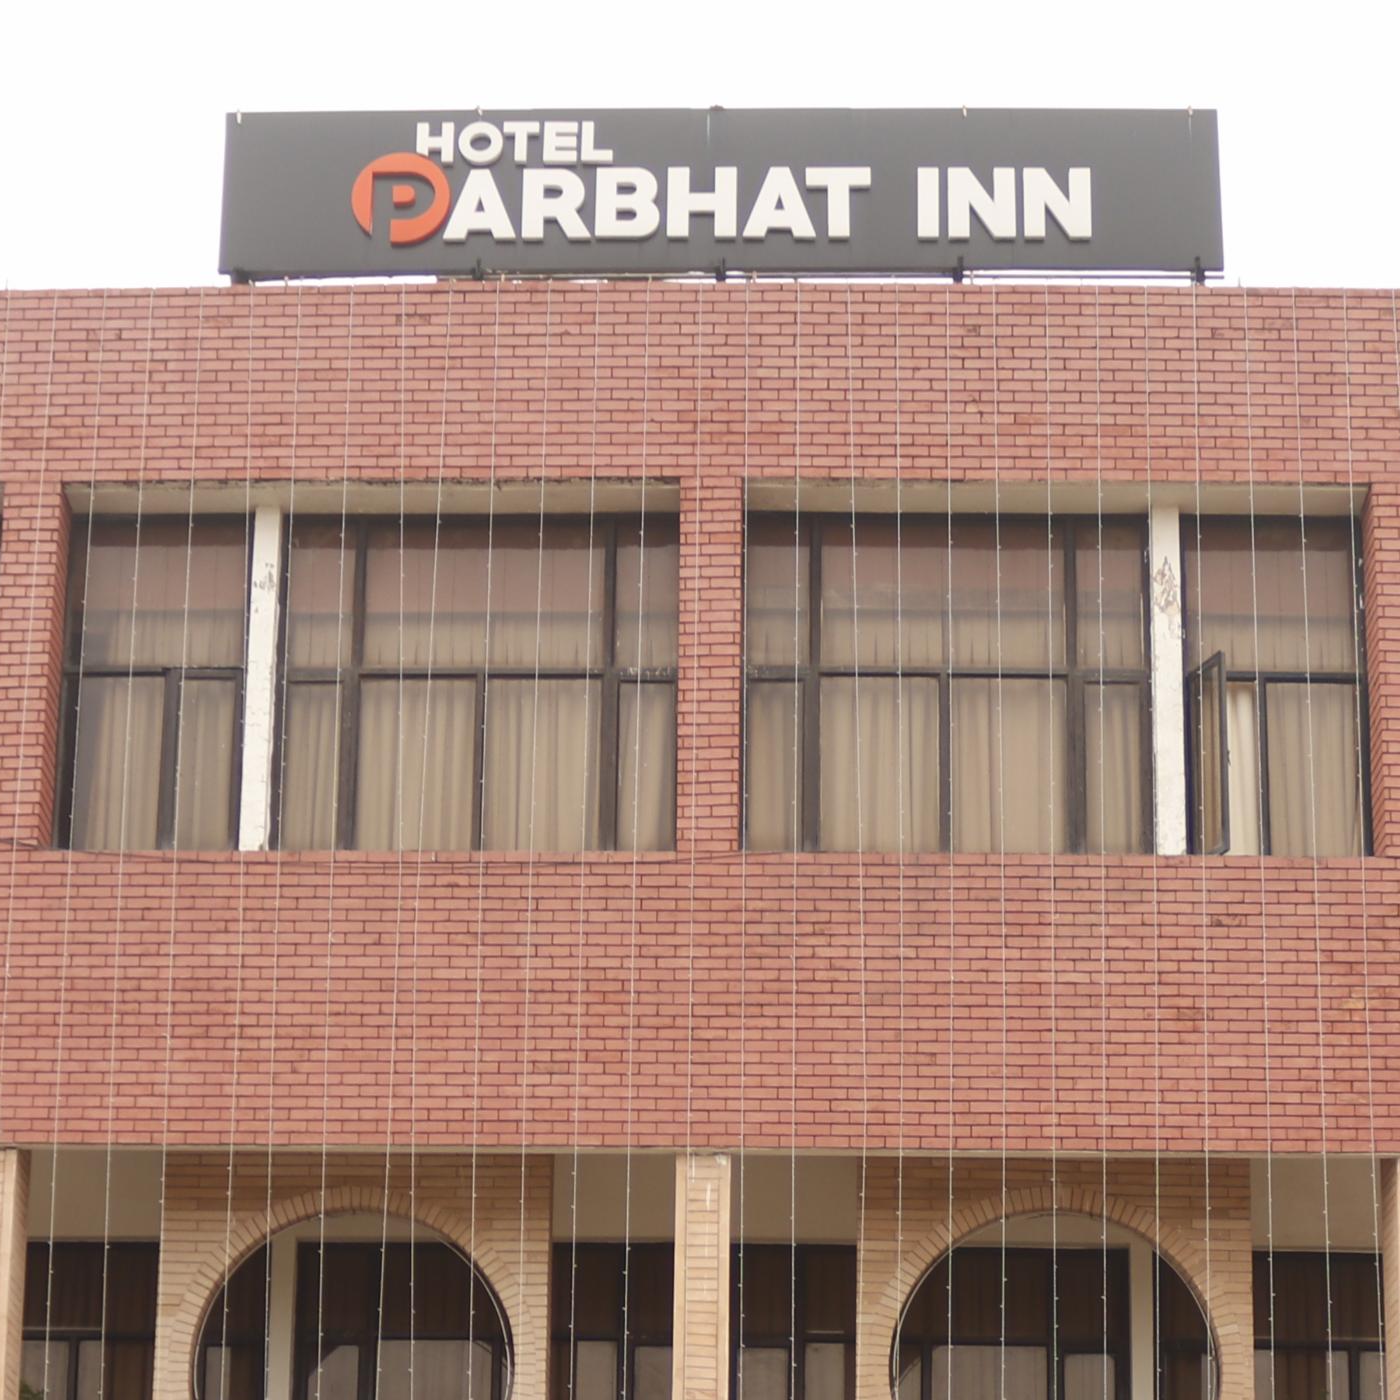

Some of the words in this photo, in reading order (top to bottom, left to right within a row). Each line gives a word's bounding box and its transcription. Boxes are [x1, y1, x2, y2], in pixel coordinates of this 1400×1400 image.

[415, 120, 614, 167] HOTEL
[352, 152, 871, 244] PARBHAT
[917, 166, 1093, 242] INN
